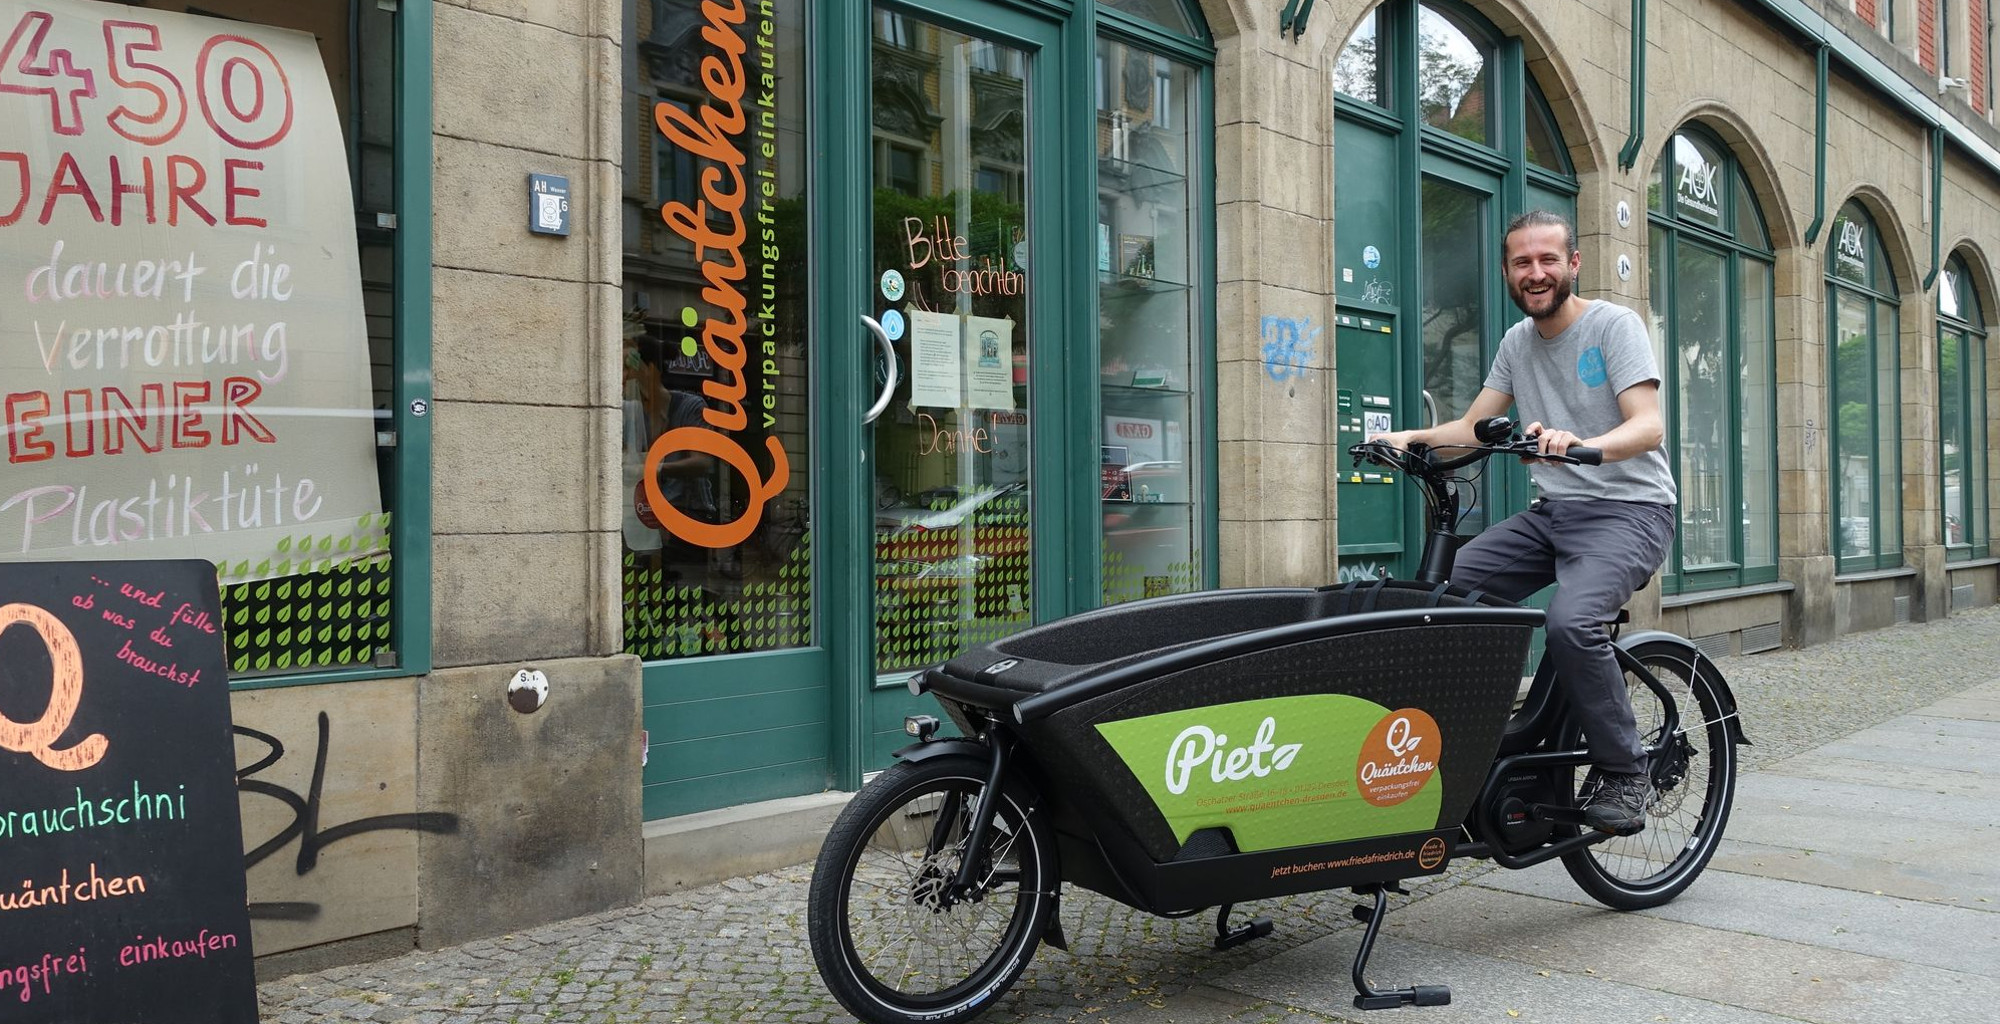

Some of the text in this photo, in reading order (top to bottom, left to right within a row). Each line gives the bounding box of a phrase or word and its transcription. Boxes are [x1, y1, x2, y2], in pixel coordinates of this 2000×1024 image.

[0, 11, 293, 149] 450
[0, 152, 267, 227] JAHRE
[1678, 162, 1718, 205] AOK
[757, 0, 780, 428] verpackungsfrei einkaufen
[1838, 220, 1864, 258] AOK
[904, 215, 971, 269] Bitte
[26, 240, 293, 302] dauert die
[644, 0, 789, 549] Quäntchen
[941, 257, 1024, 296] beachten
[34, 310, 288, 383] Verrottung
[4, 376, 278, 463] EINER
[0, 463, 323, 554] Plastiktüte
[72, 594, 174, 649] ab was du
[120, 580, 163, 609] und
[170, 602, 217, 634] fülle
[116, 640, 201, 689] brauchst
[1165, 716, 1276, 795] Piet
[1386, 717, 1409, 757] Q
[1361, 755, 1434, 785] Quäntchen
[1369, 780, 1420, 793] verpackungsfrei
[1376, 791, 1408, 801] einkaufen
[1271, 849, 1416, 879] jetzt buchen: www.friedafriedrich.de
[119, 929, 237, 967] einkaufen
